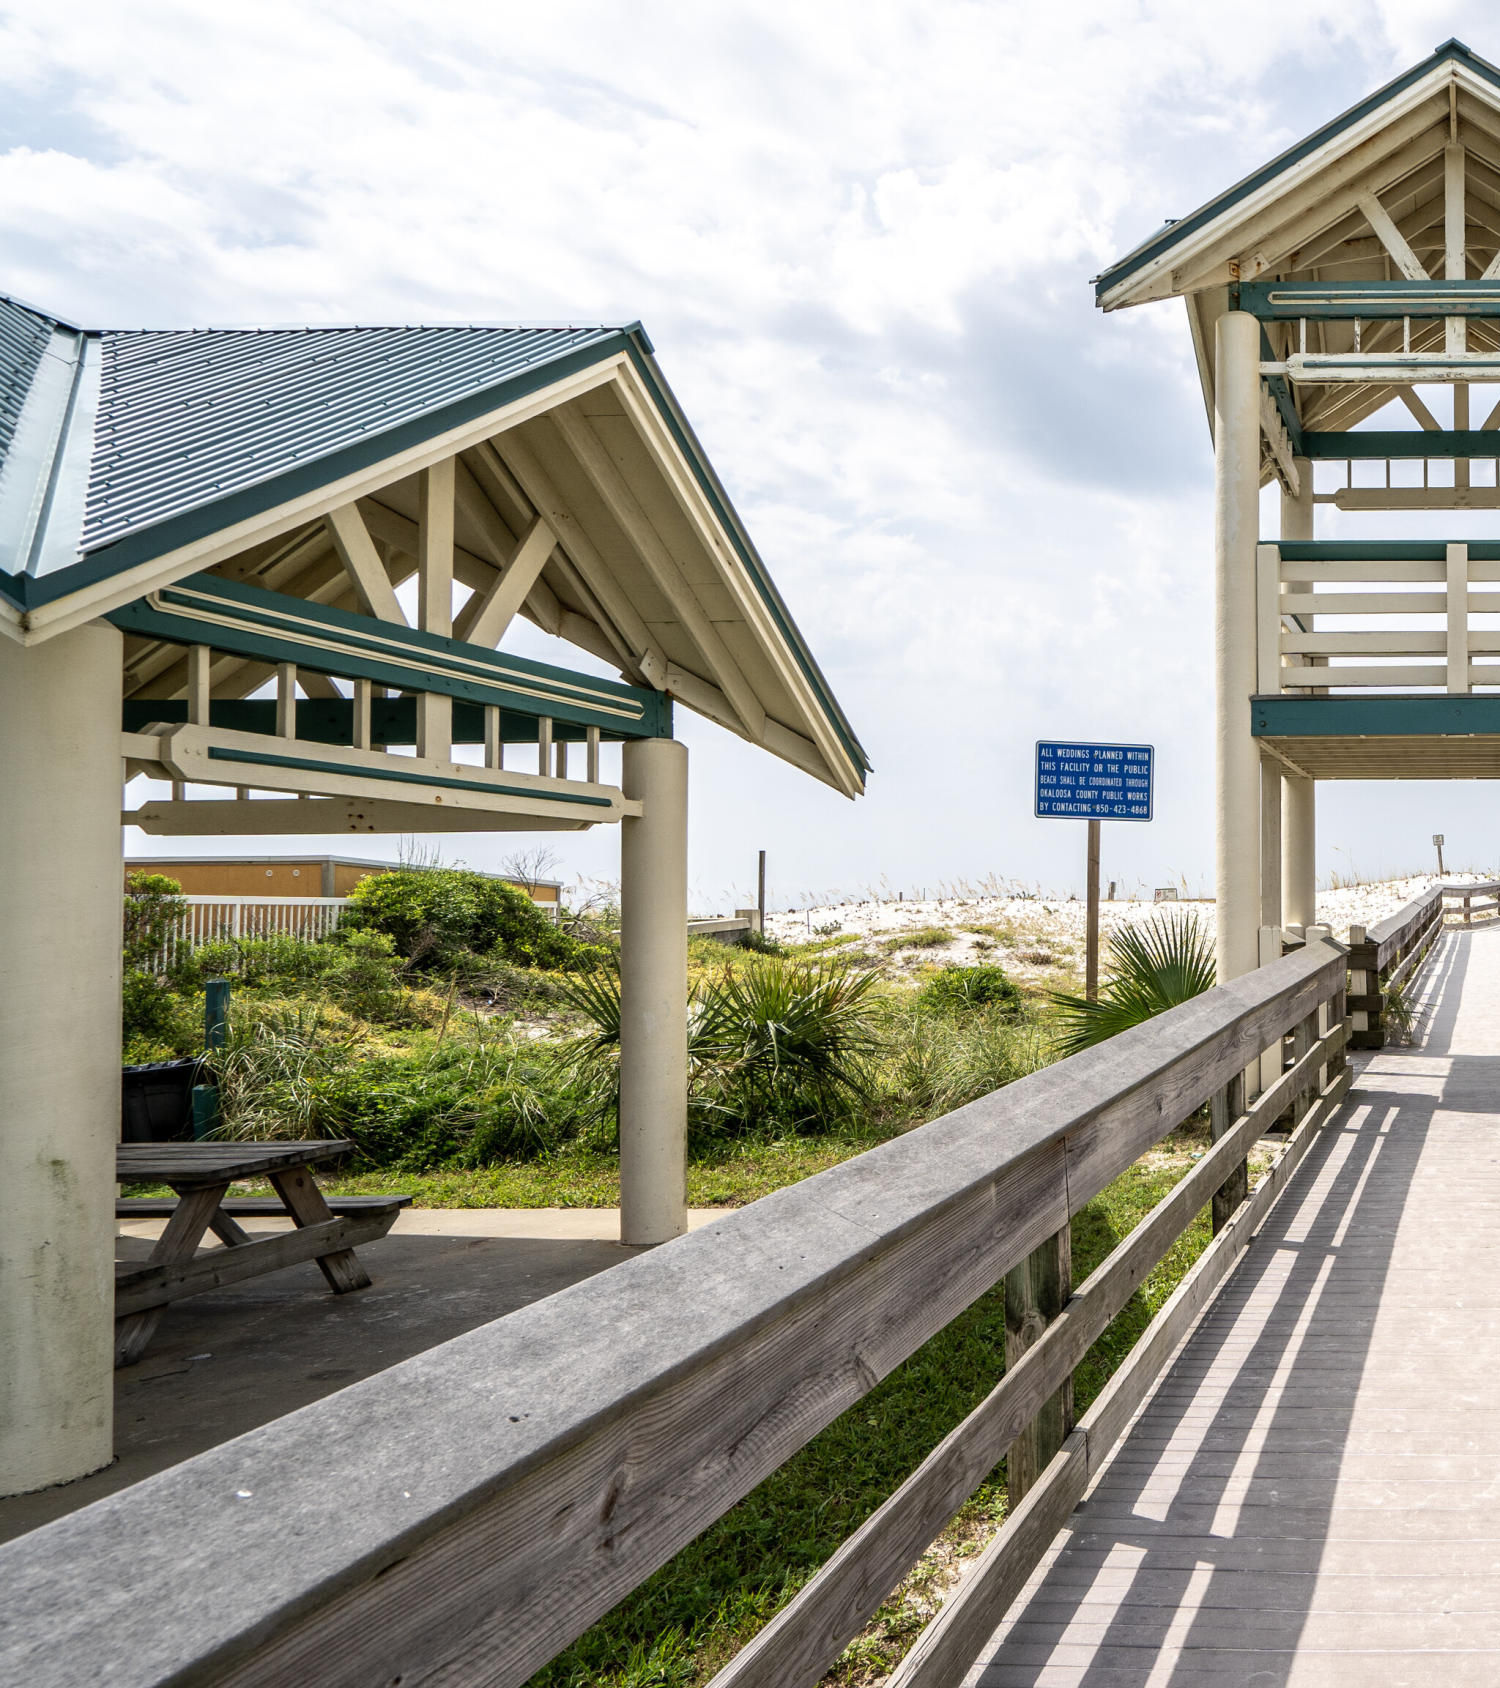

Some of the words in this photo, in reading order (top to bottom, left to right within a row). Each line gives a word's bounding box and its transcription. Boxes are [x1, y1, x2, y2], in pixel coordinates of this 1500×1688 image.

[1041, 748, 1053, 757] ALL
[1057, 749, 1090, 758] WEDDINGS
[1094, 750, 1123, 760] PLANNED
[1127, 752, 1148, 761] WITHIN
[1041, 762, 1056, 771] THIS
[1060, 763, 1090, 772] FACILITY
[1094, 764, 1103, 773] OR
[1107, 764, 1119, 773] THE
[1124, 765, 1148, 774] PUBLIC
[1040, 775, 1056, 784] BEACH
[1060, 776, 1076, 785] SHALL
[1079, 777, 1085, 786] BE
[1089, 777, 1122, 786] COORDINATED
[1126, 779, 1148, 787] THROUGH
[1040, 789, 1071, 798] OKALOOSA
[1076, 790, 1098, 799] COUNTY
[1102, 791, 1123, 800] PUBLIC
[1127, 792, 1148, 801] WORKS
[1040, 802, 1048, 811] BY
[1052, 803, 1091, 812] CONTACTING
